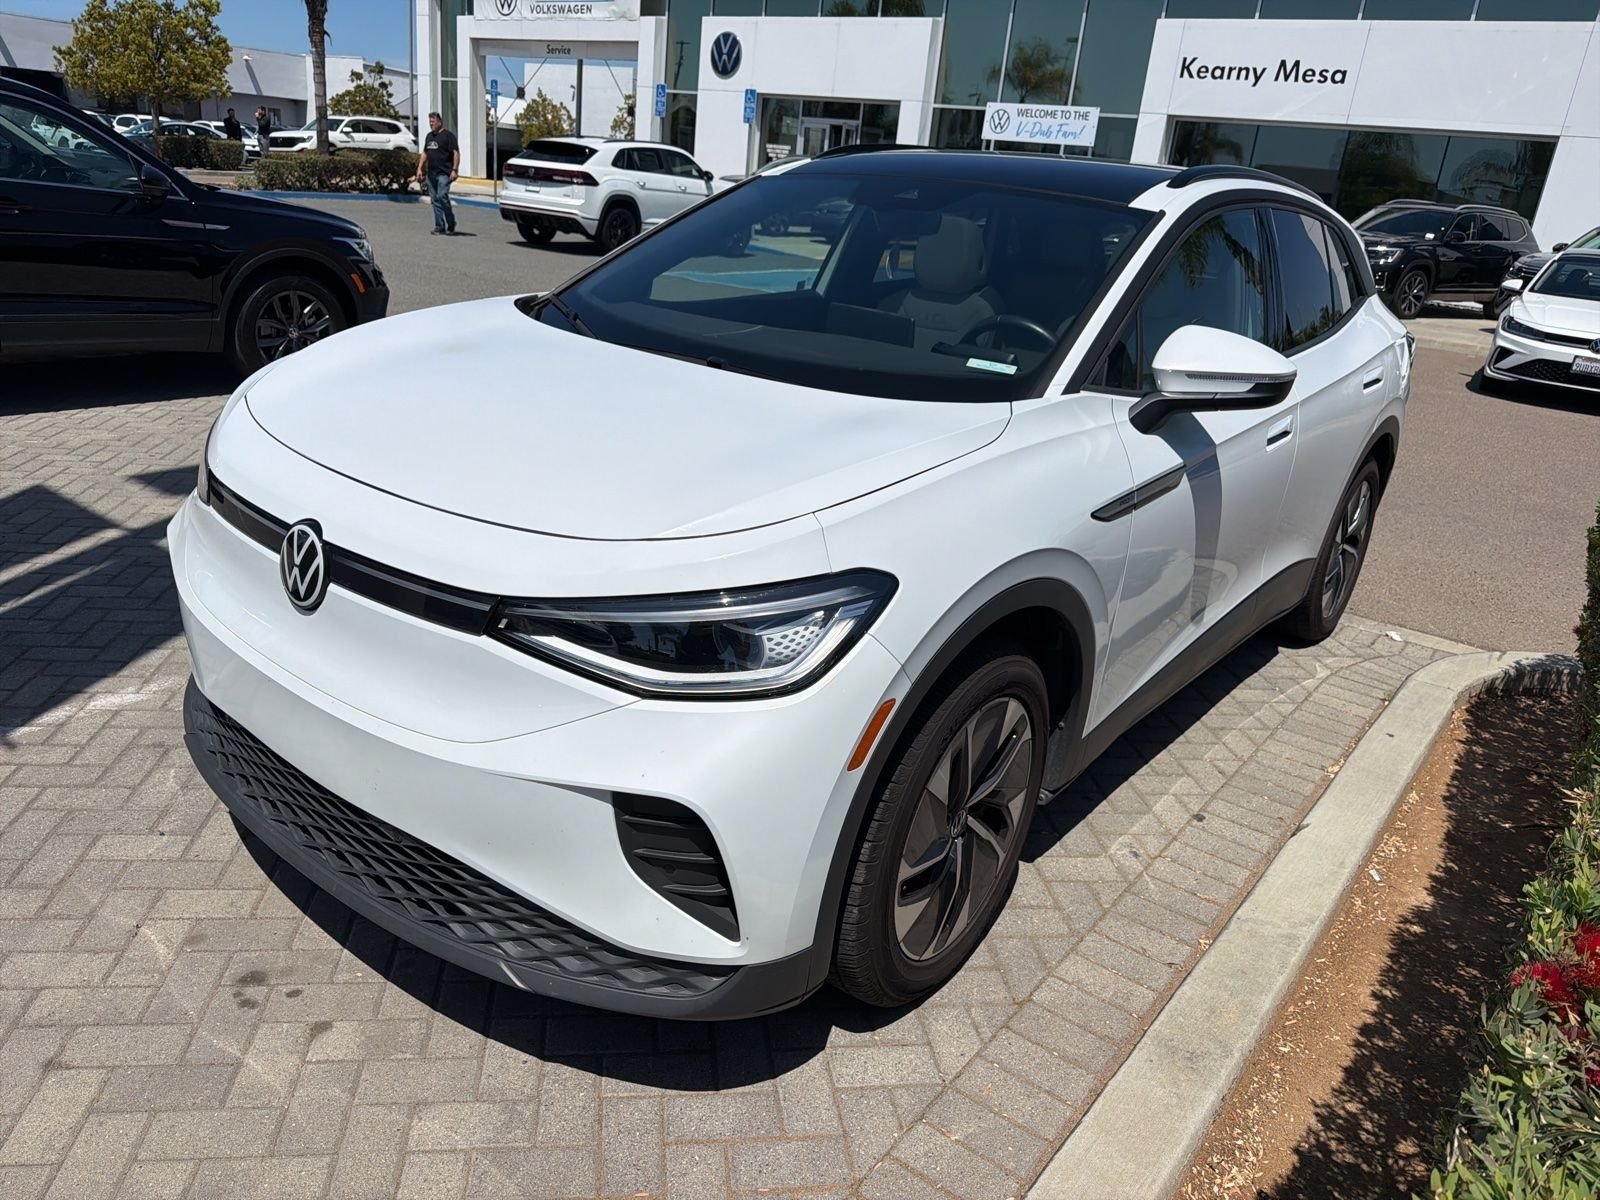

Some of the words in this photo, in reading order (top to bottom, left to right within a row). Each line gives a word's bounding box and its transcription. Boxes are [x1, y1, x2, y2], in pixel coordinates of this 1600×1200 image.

[529, 4, 593, 15] VOLKSWAGEN
[546, 44, 572, 55] Service
[1179, 56, 1267, 87] Kearny
[1273, 59, 1348, 84] Mesa
[1016, 108, 1058, 120] WELCOME
[1060, 110, 1071, 120] TO
[1073, 111, 1091, 121] THE
[1015, 121, 1053, 139] V-Dub
[1055, 123, 1086, 140] Fam!
